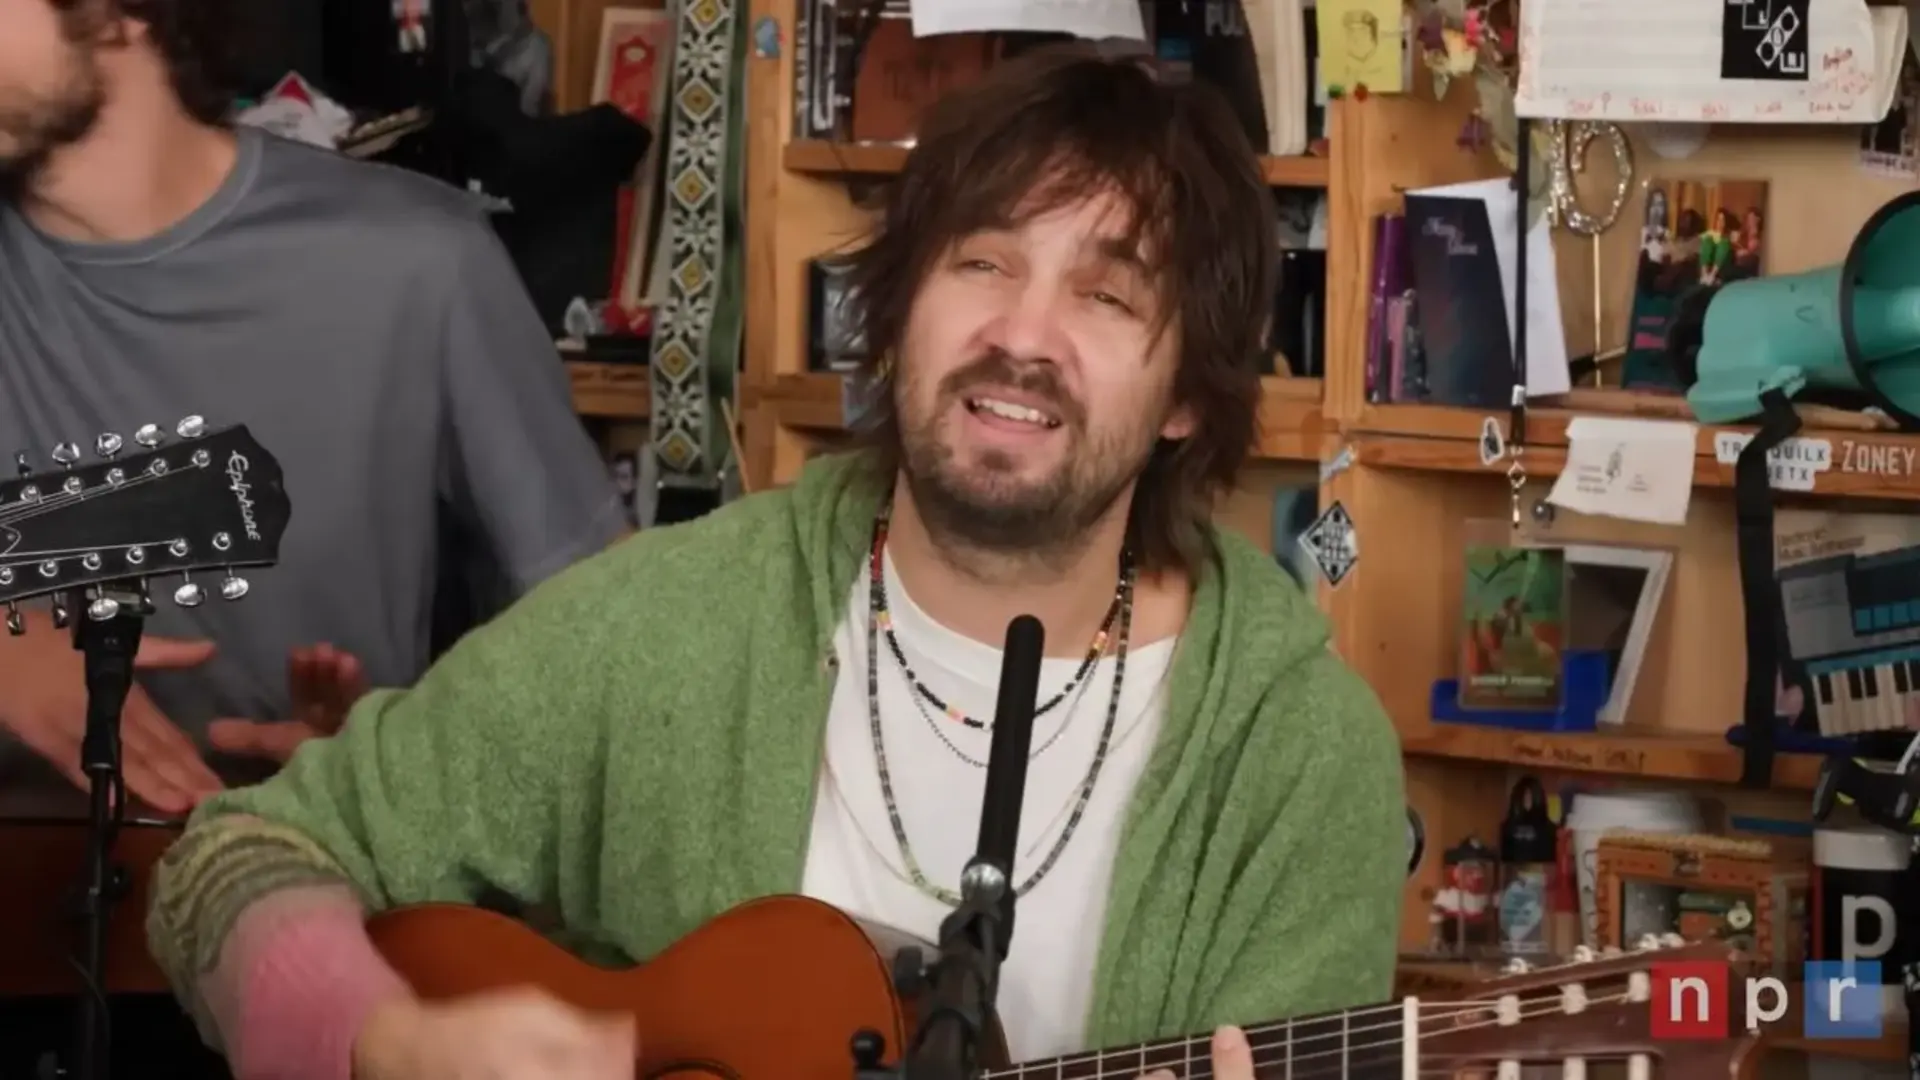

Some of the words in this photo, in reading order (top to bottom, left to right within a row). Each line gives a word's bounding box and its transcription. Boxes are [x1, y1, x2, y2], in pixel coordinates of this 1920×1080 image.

[1721, 440, 1826, 462] TRQUILX
[1842, 440, 1916, 476] ZONEY
[225, 449, 262, 541] Epiphone
